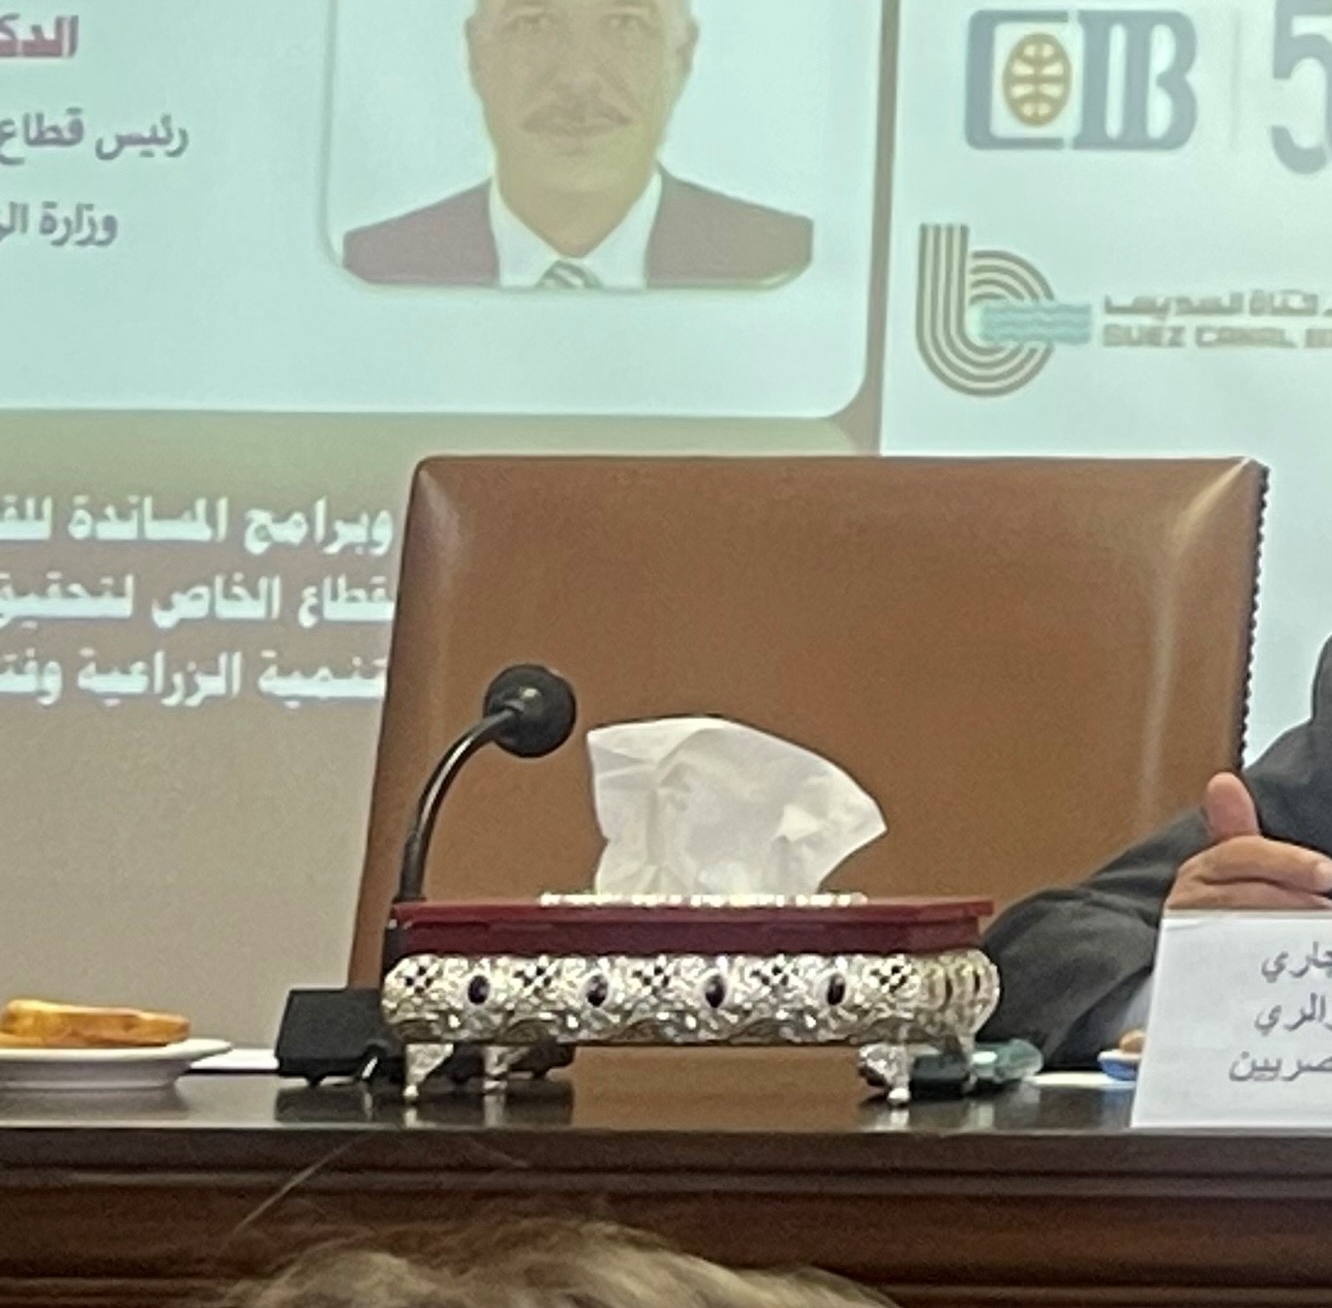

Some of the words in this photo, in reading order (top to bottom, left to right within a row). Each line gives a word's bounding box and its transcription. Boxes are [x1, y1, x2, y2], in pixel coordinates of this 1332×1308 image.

[95, 113, 189, 161] رئيس
[39, 200, 119, 247] وزارة
[244, 495, 394, 556] وبرامج
[151, 572, 282, 629] الخاص
[77, 647, 243, 706] الزراعية
